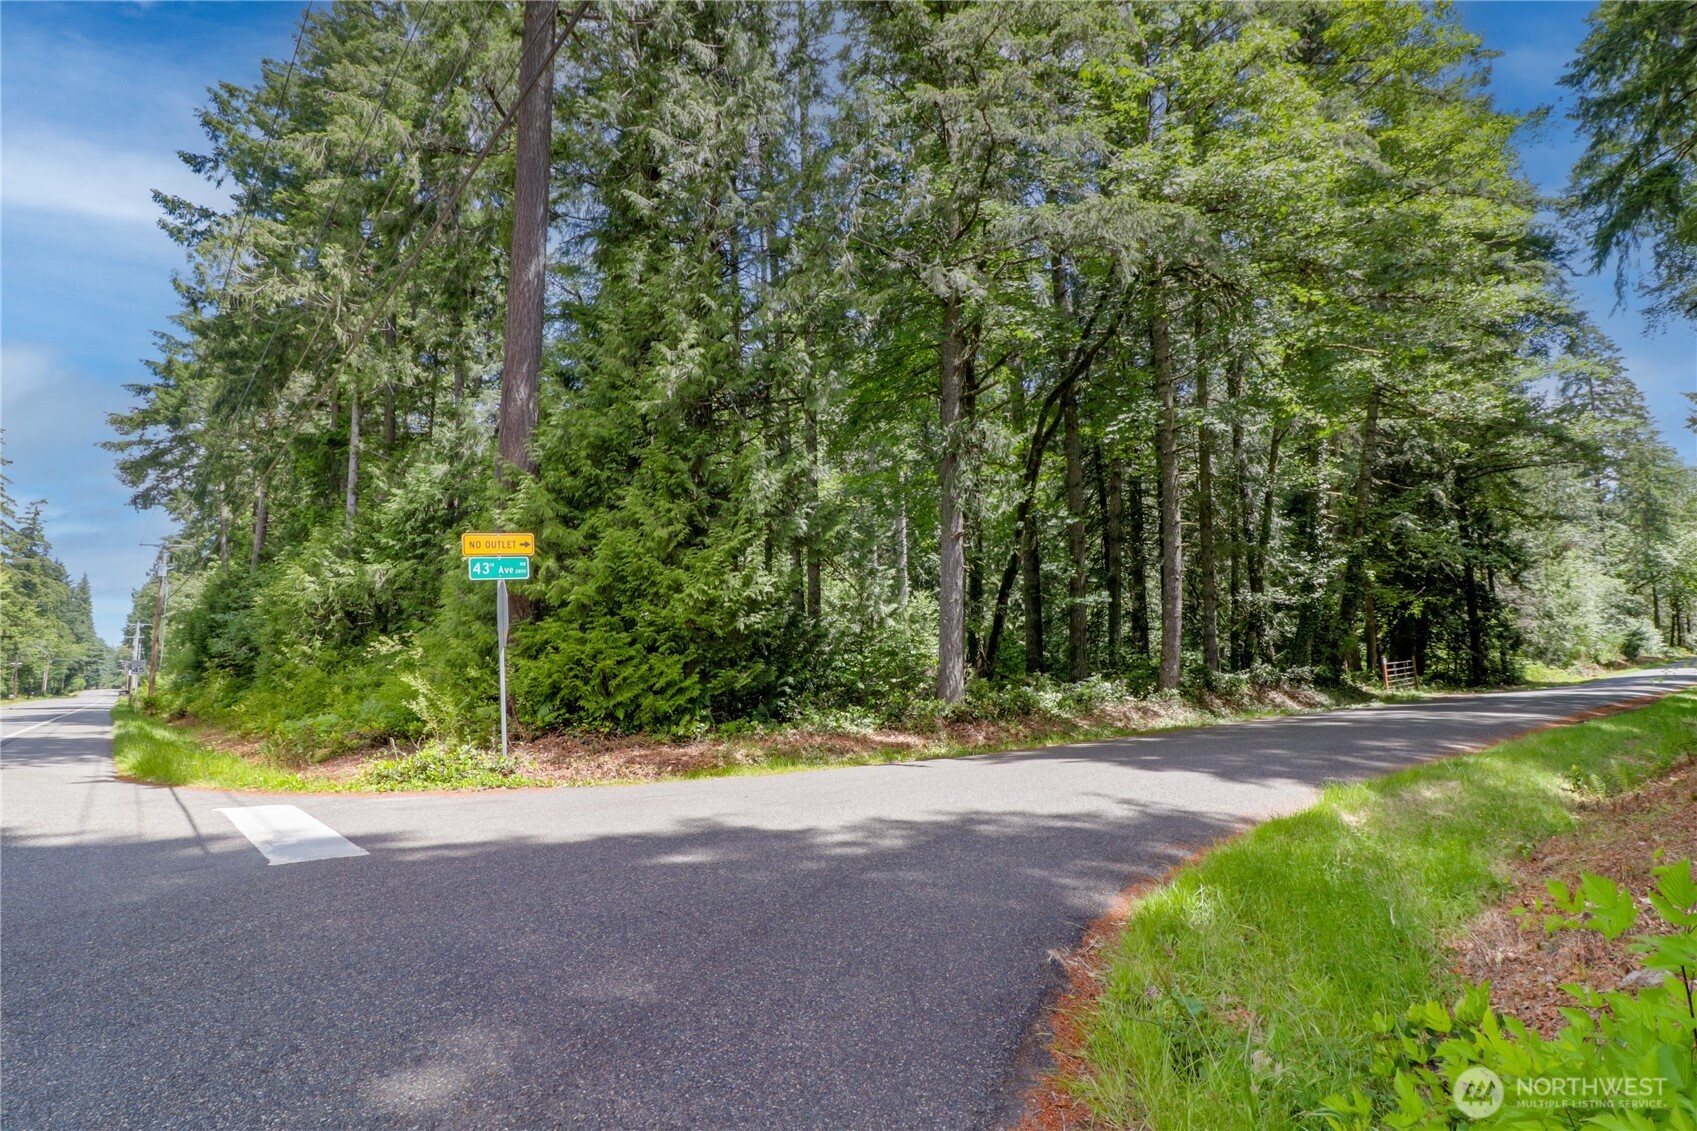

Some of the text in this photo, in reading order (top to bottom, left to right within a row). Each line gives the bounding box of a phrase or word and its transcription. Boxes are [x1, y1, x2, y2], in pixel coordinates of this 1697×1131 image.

[470, 540, 516, 548] NO OUTLET
[498, 566, 513, 574] Ave
